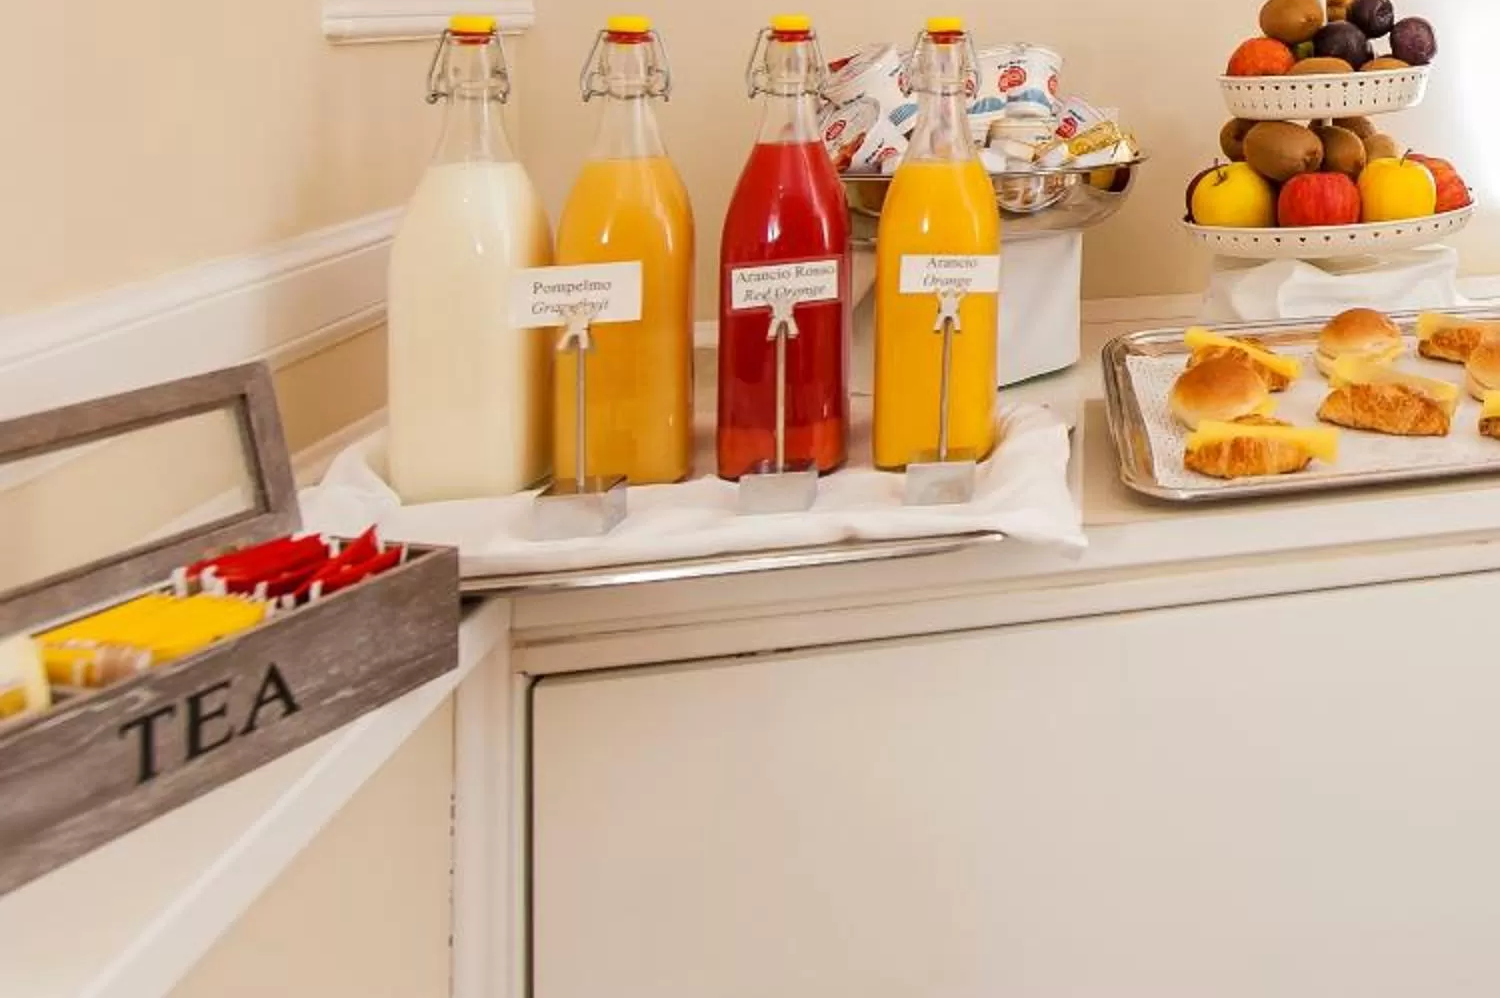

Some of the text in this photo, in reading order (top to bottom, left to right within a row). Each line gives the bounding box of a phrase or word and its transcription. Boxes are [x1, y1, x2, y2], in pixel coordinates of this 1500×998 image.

[926, 257, 979, 269] Arancio
[736, 265, 835, 283] Arancio Rosso
[532, 279, 612, 296] Pompelmo
[743, 286, 772, 302] Red
[118, 661, 301, 786] TEA
